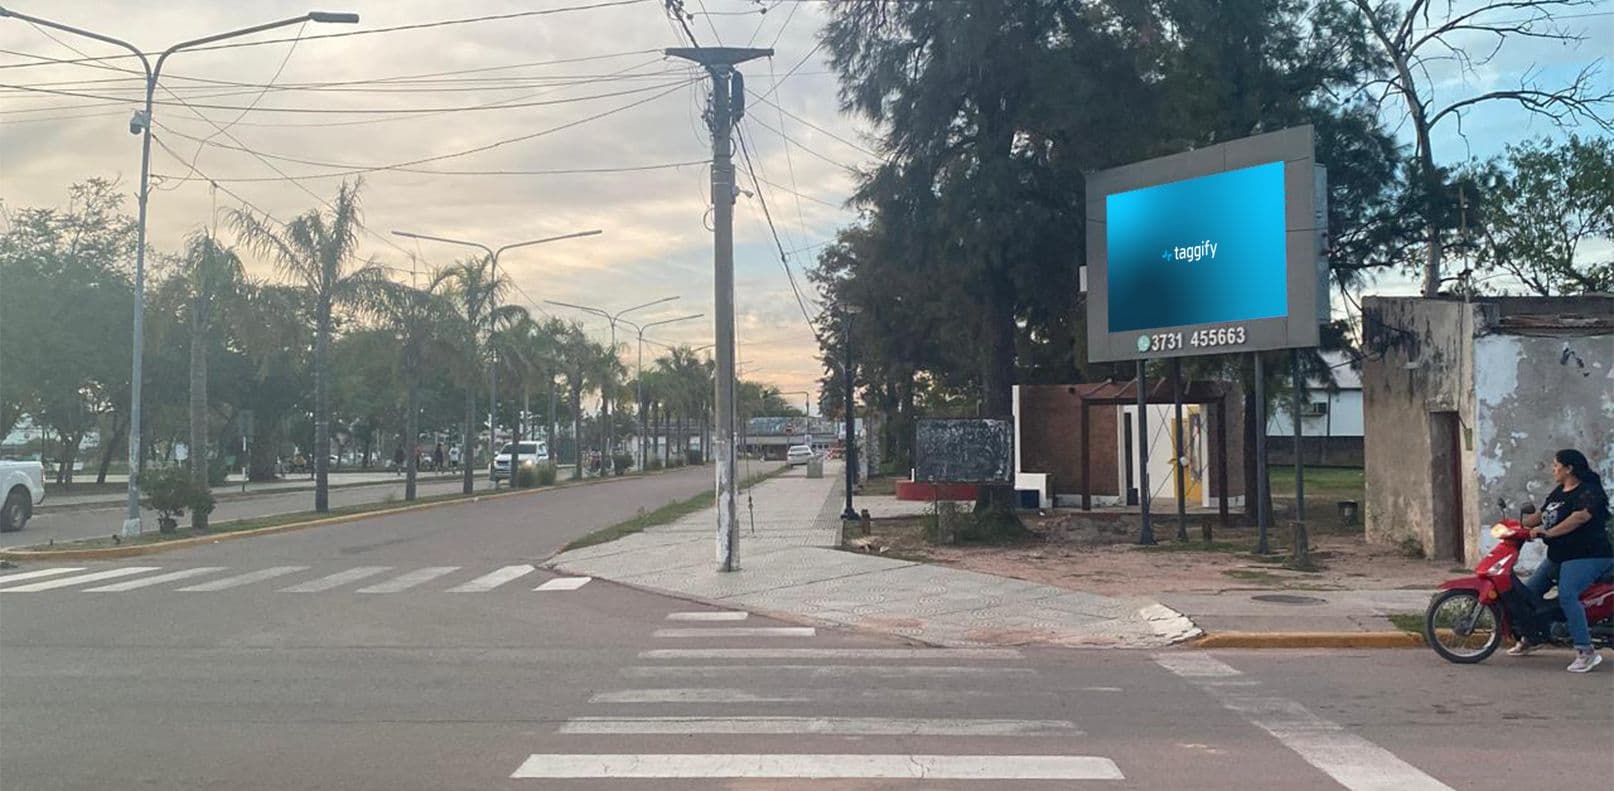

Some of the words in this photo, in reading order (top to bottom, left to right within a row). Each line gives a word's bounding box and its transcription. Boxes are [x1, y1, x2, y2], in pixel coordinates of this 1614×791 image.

[1174, 240, 1218, 262] taggify
[1151, 333, 1182, 351] 3731
[1191, 327, 1246, 347] 455663
